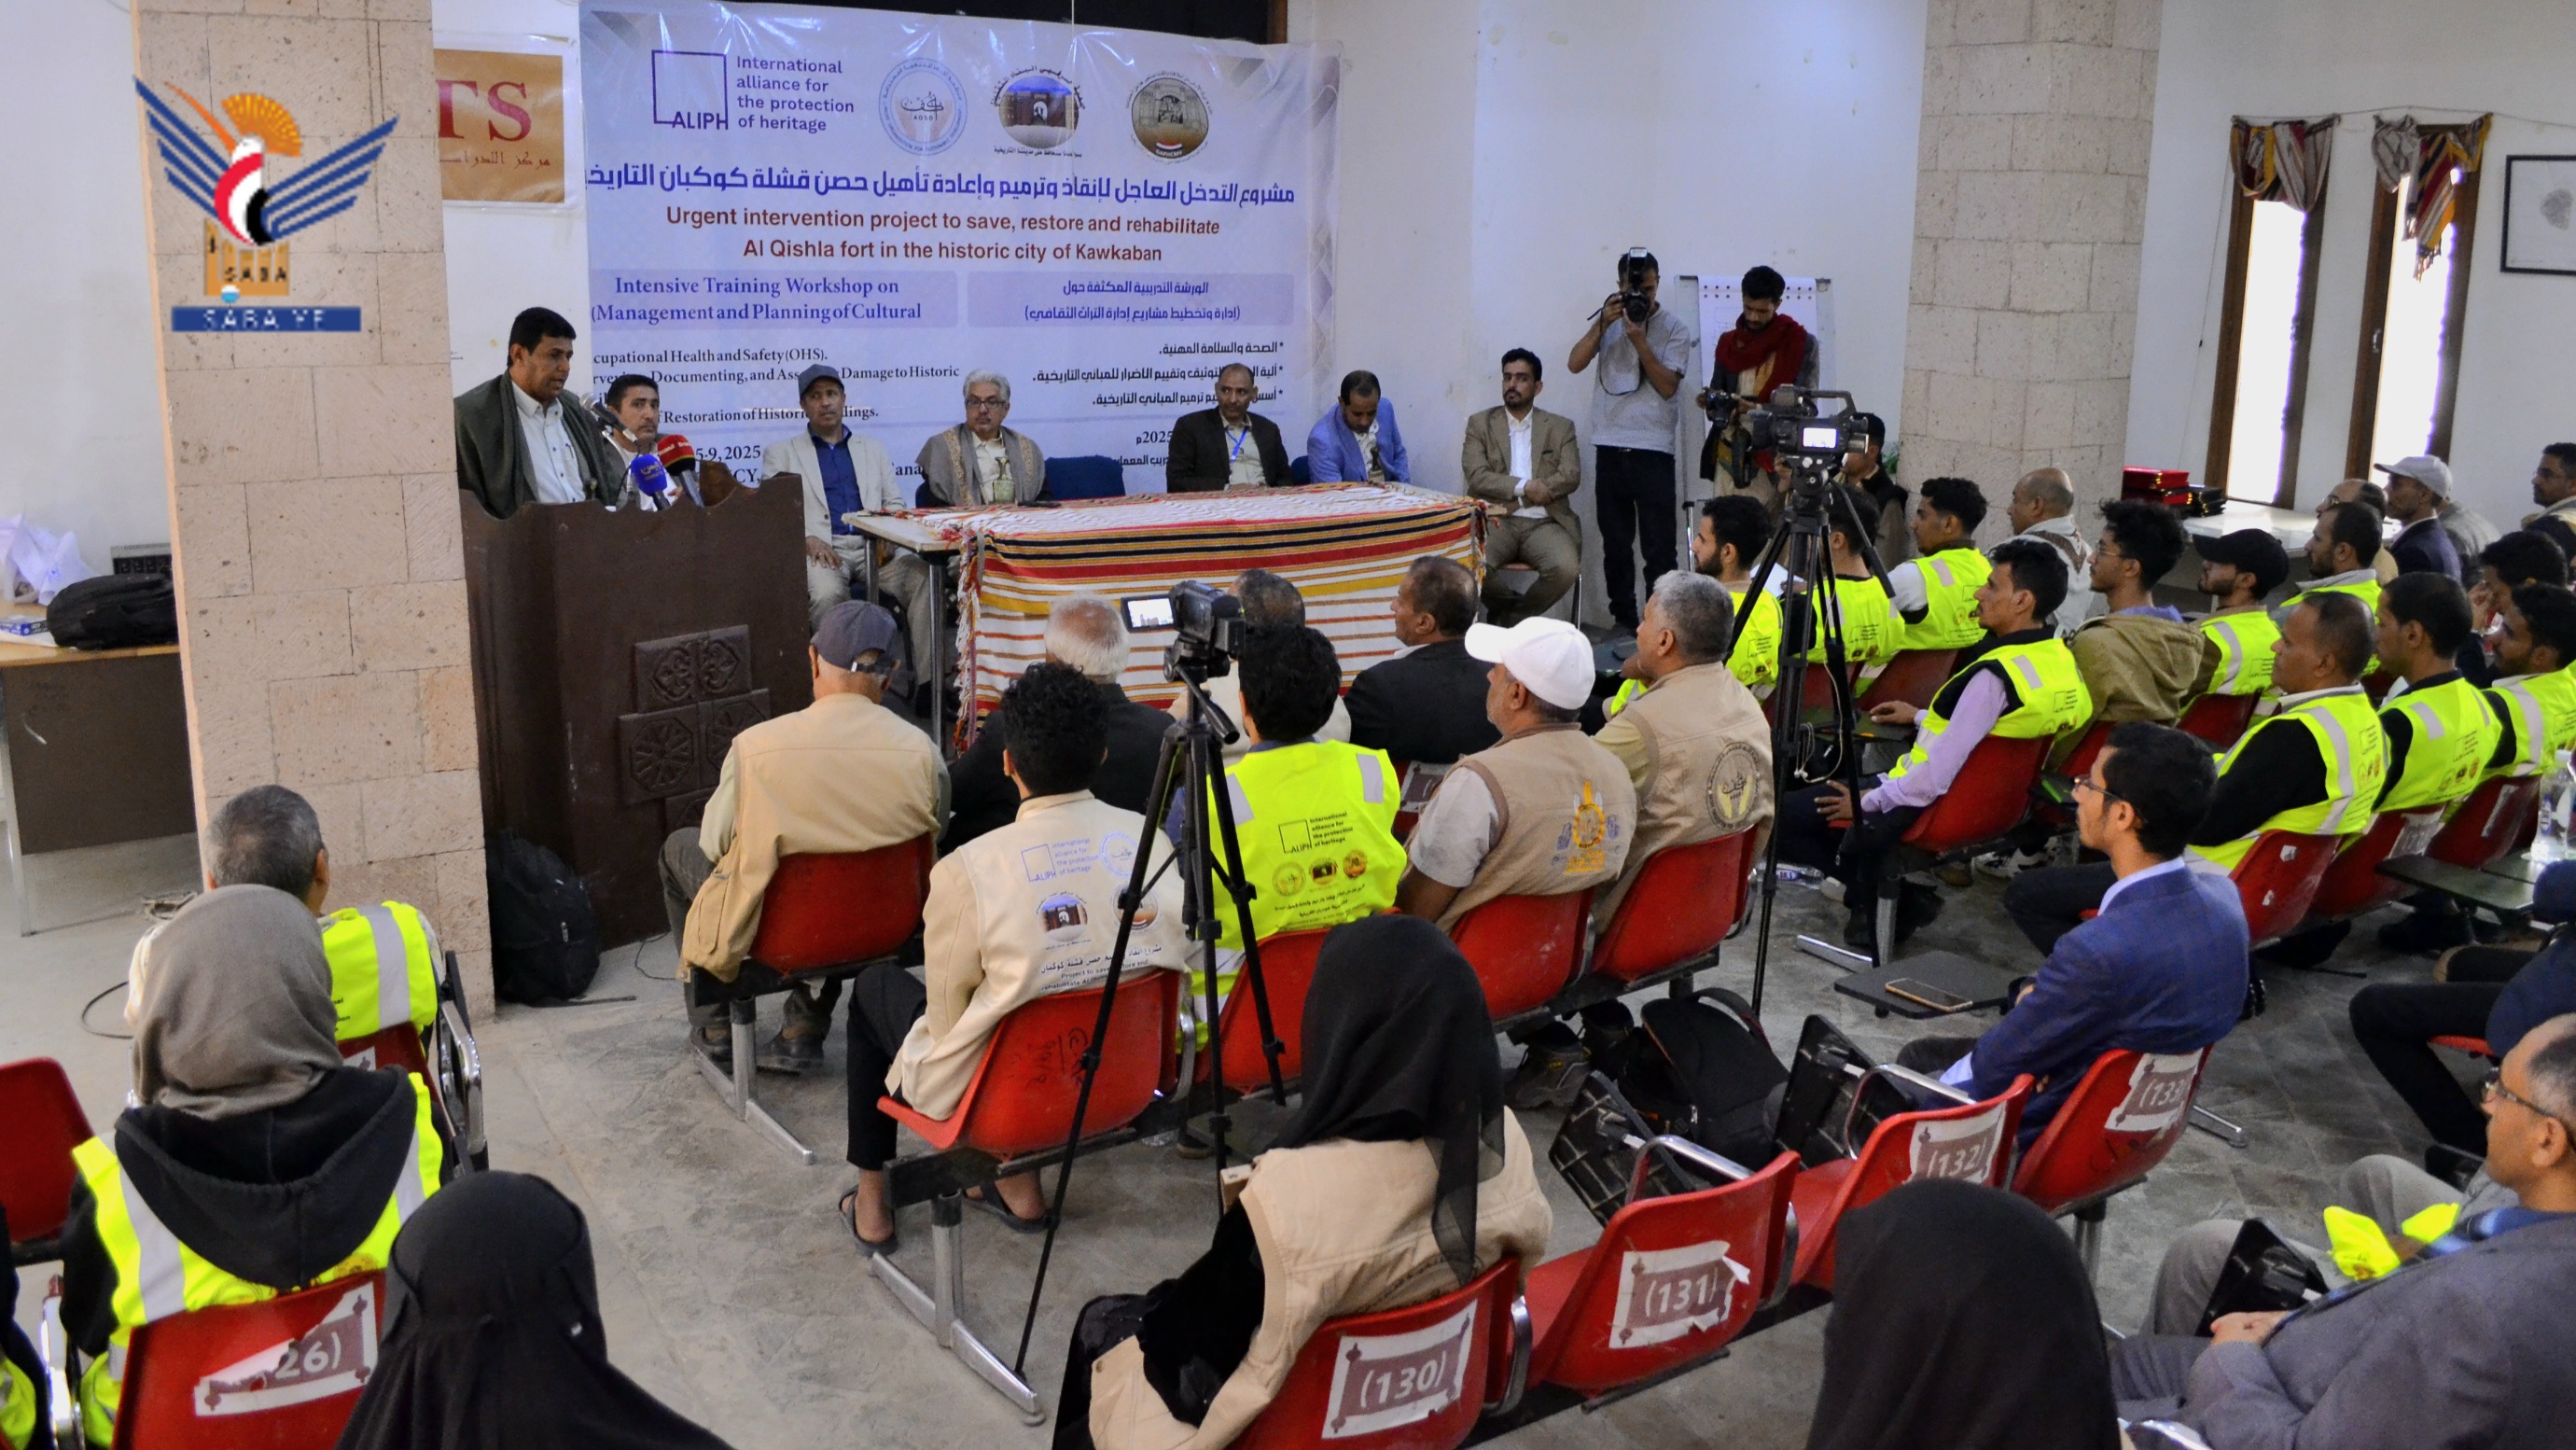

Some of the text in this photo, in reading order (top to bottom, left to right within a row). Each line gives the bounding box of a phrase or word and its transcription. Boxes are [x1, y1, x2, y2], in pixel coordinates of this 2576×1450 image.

[737, 56, 842, 73] International
[737, 76, 828, 92] alliance for
[737, 95, 855, 112] the protection
[671, 111, 729, 131] ALIPH
[738, 115, 827, 133] of heritage
[515, 152, 550, 170] مركز
[585, 162, 1295, 209] مشروع التدخل العاجل لإنقاذ وترميم وإعادة تأهيل حصن قشلة كوكبان التاريخ
[666, 205, 1220, 235] Urgent intervention project to save, restore and rehabilitate
[743, 239, 1162, 264] Al Qishla fort in the historic city of Kawkaban
[615, 276, 898, 298] Intensive Training Workshop on
[1063, 280, 1209, 297] الورشة التدريبية المكثفة حول
[591, 303, 922, 326] (Management and Planning of Cultural
[1024, 305, 1241, 323] (إدارة وتخطيط مشاريع إدارة التراث الثقافي)
[1159, 342, 1277, 356] الصحة والسلامة المهنية.
[592, 348, 828, 367] cupational Health and Safety (OHS).
[652, 366, 960, 385] Documenting, and Ass Damage to Historic
[1032, 369, 1080, 383] التاريخية.
[1081, 368, 1120, 382] للمباني
[1154, 368, 1186, 383] وتقييم
[1187, 366, 1221, 381] لتوثيق
[1093, 392, 1137, 407] التاريخية.
[1138, 392, 1178, 405] المباني
[1179, 391, 1204, 406] ترميم
[664, 404, 879, 424] Restoration of Histori dings.
[725, 445, 761, 461] 2025
[734, 469, 760, 485] CY,
[1310, 812, 1347, 822] International
[1324, 827, 1353, 838] protection
[1052, 838, 1090, 848] International
[1321, 838, 1345, 846] heritage
[1068, 855, 1099, 866] protection
[1035, 871, 1057, 883] ALIPH
[1067, 866, 1091, 874] heritage
[1061, 970, 1084, 980] Project
[1927, 1136, 1986, 1176] (132)
[1644, 1267, 1719, 1318] (131)
[275, 1331, 342, 1380] 26)
[1359, 1350, 1446, 1409] (130)
